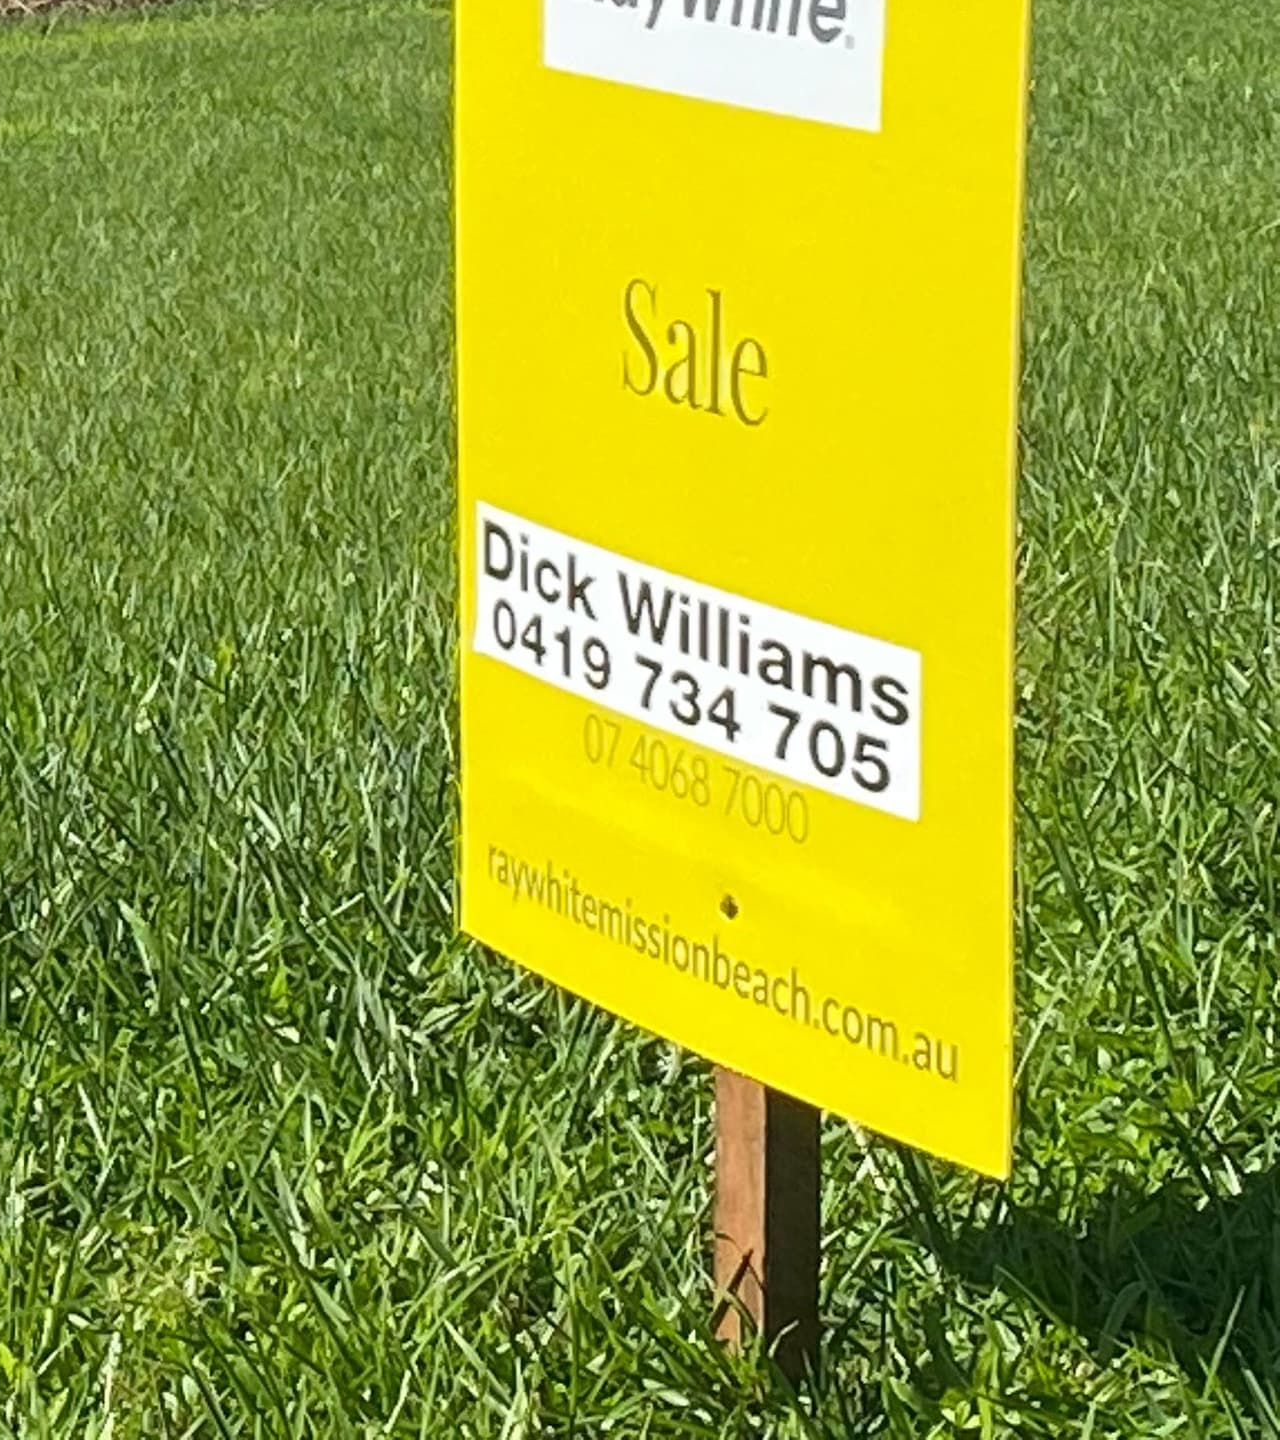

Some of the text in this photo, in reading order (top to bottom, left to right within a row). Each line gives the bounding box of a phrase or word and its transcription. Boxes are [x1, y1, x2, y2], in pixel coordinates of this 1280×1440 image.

[622, 277, 769, 427] Sale
[483, 519, 910, 726] Dick Williams
[493, 598, 892, 794] 0419 734 705
[583, 713, 808, 845] 07 4068 7000
[487, 841, 960, 1083] raywhitemissionbeach.com.au
